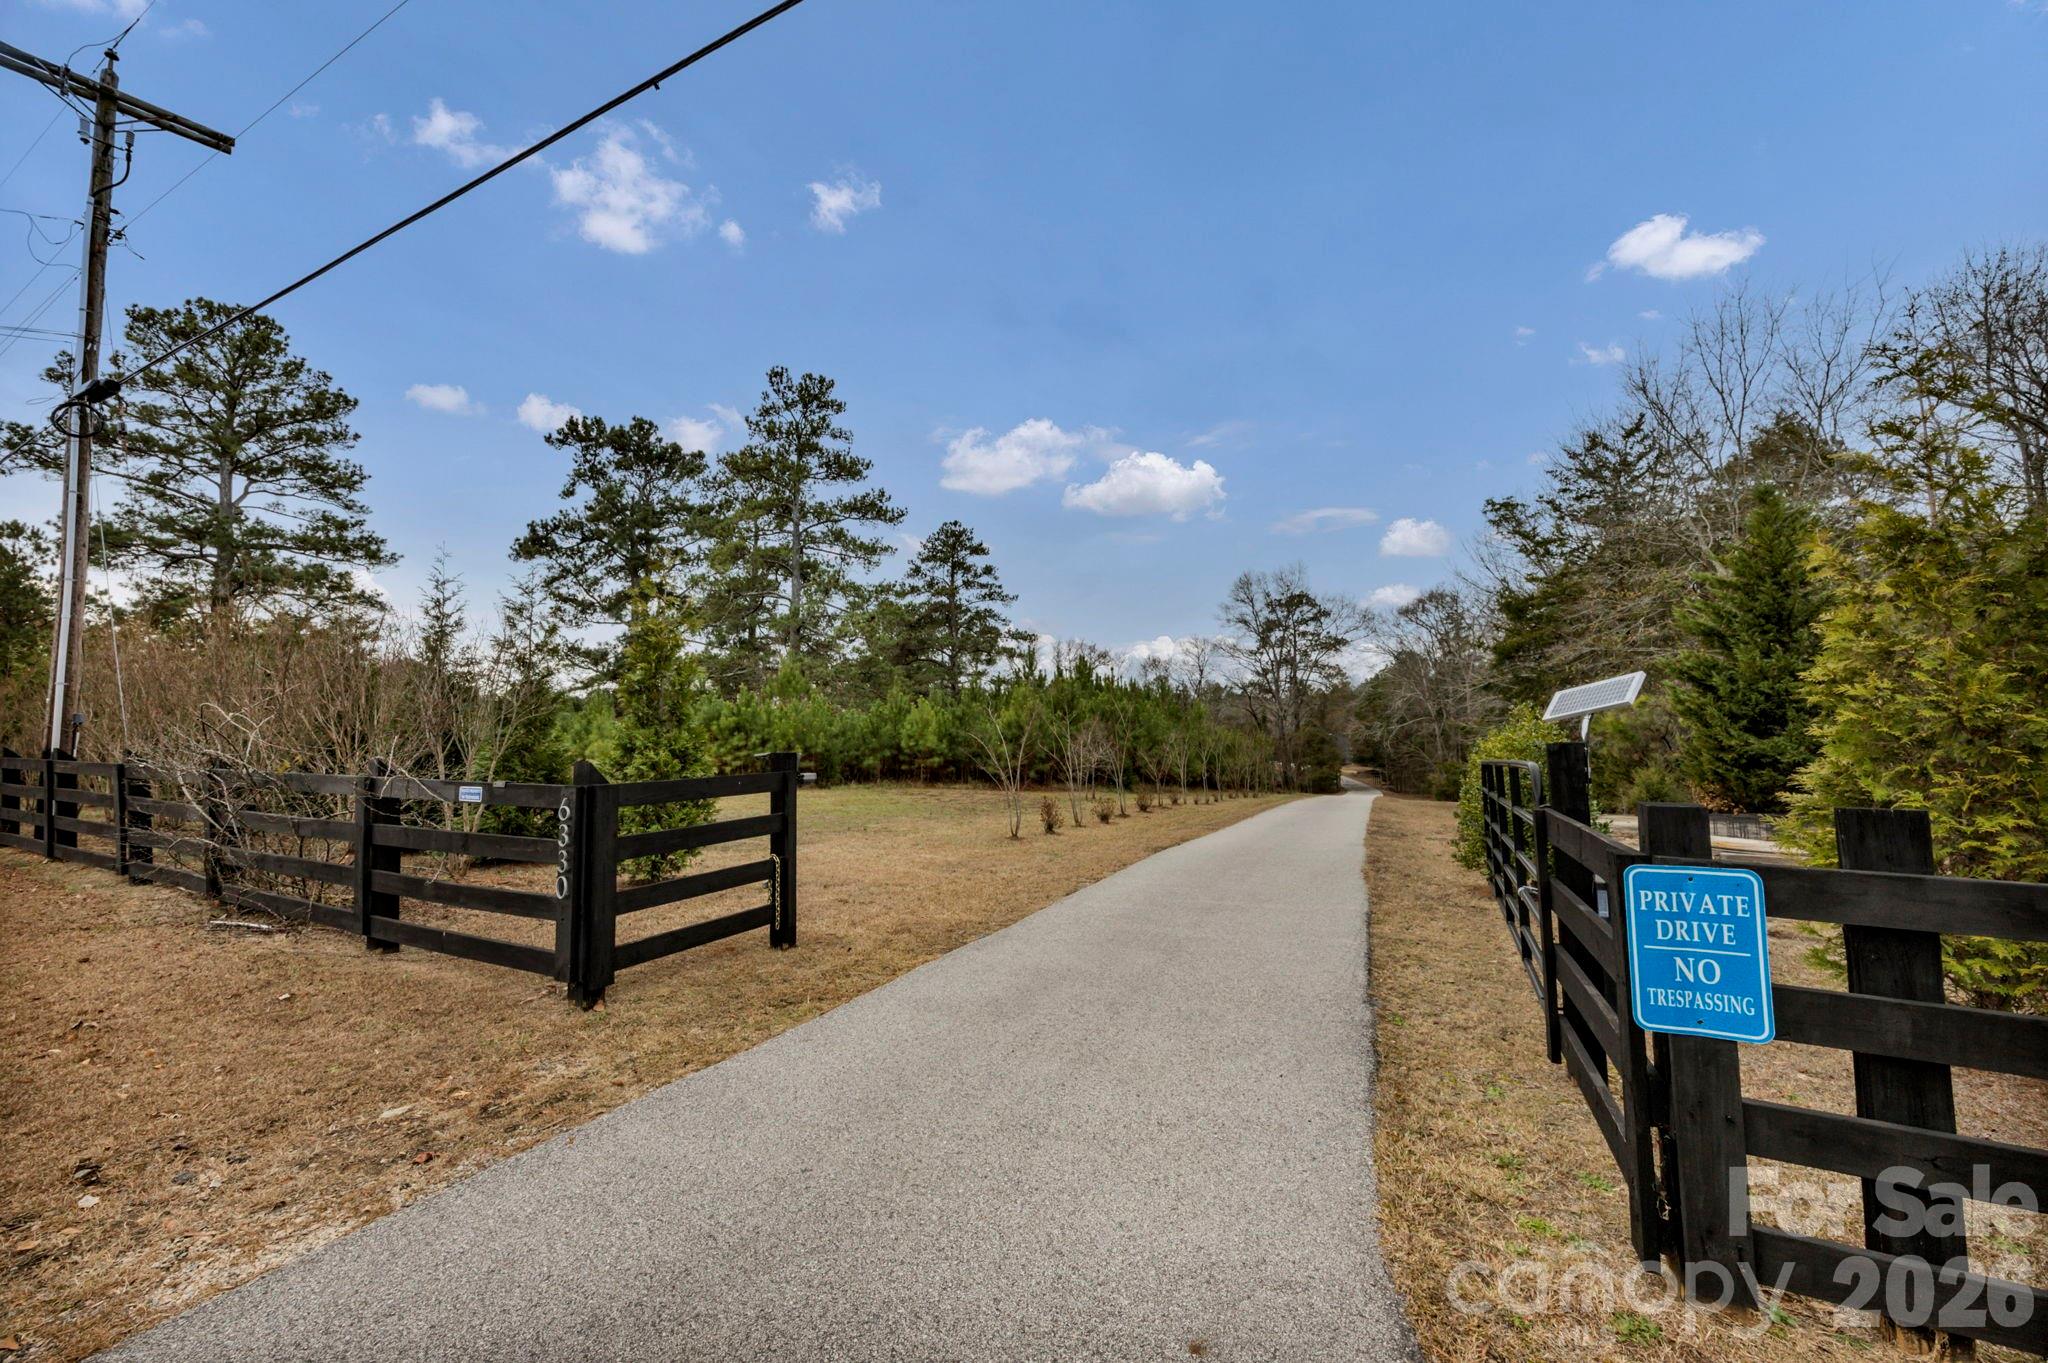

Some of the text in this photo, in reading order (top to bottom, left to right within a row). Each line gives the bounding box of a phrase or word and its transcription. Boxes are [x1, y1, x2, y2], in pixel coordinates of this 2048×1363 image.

[556, 797, 571, 899] 6330
[1638, 889, 1750, 918] PRIVATE
[1655, 919, 1736, 945] DRIVE
[1673, 956, 1721, 985] NO
[1647, 987, 1756, 1016] TRESPASSING
